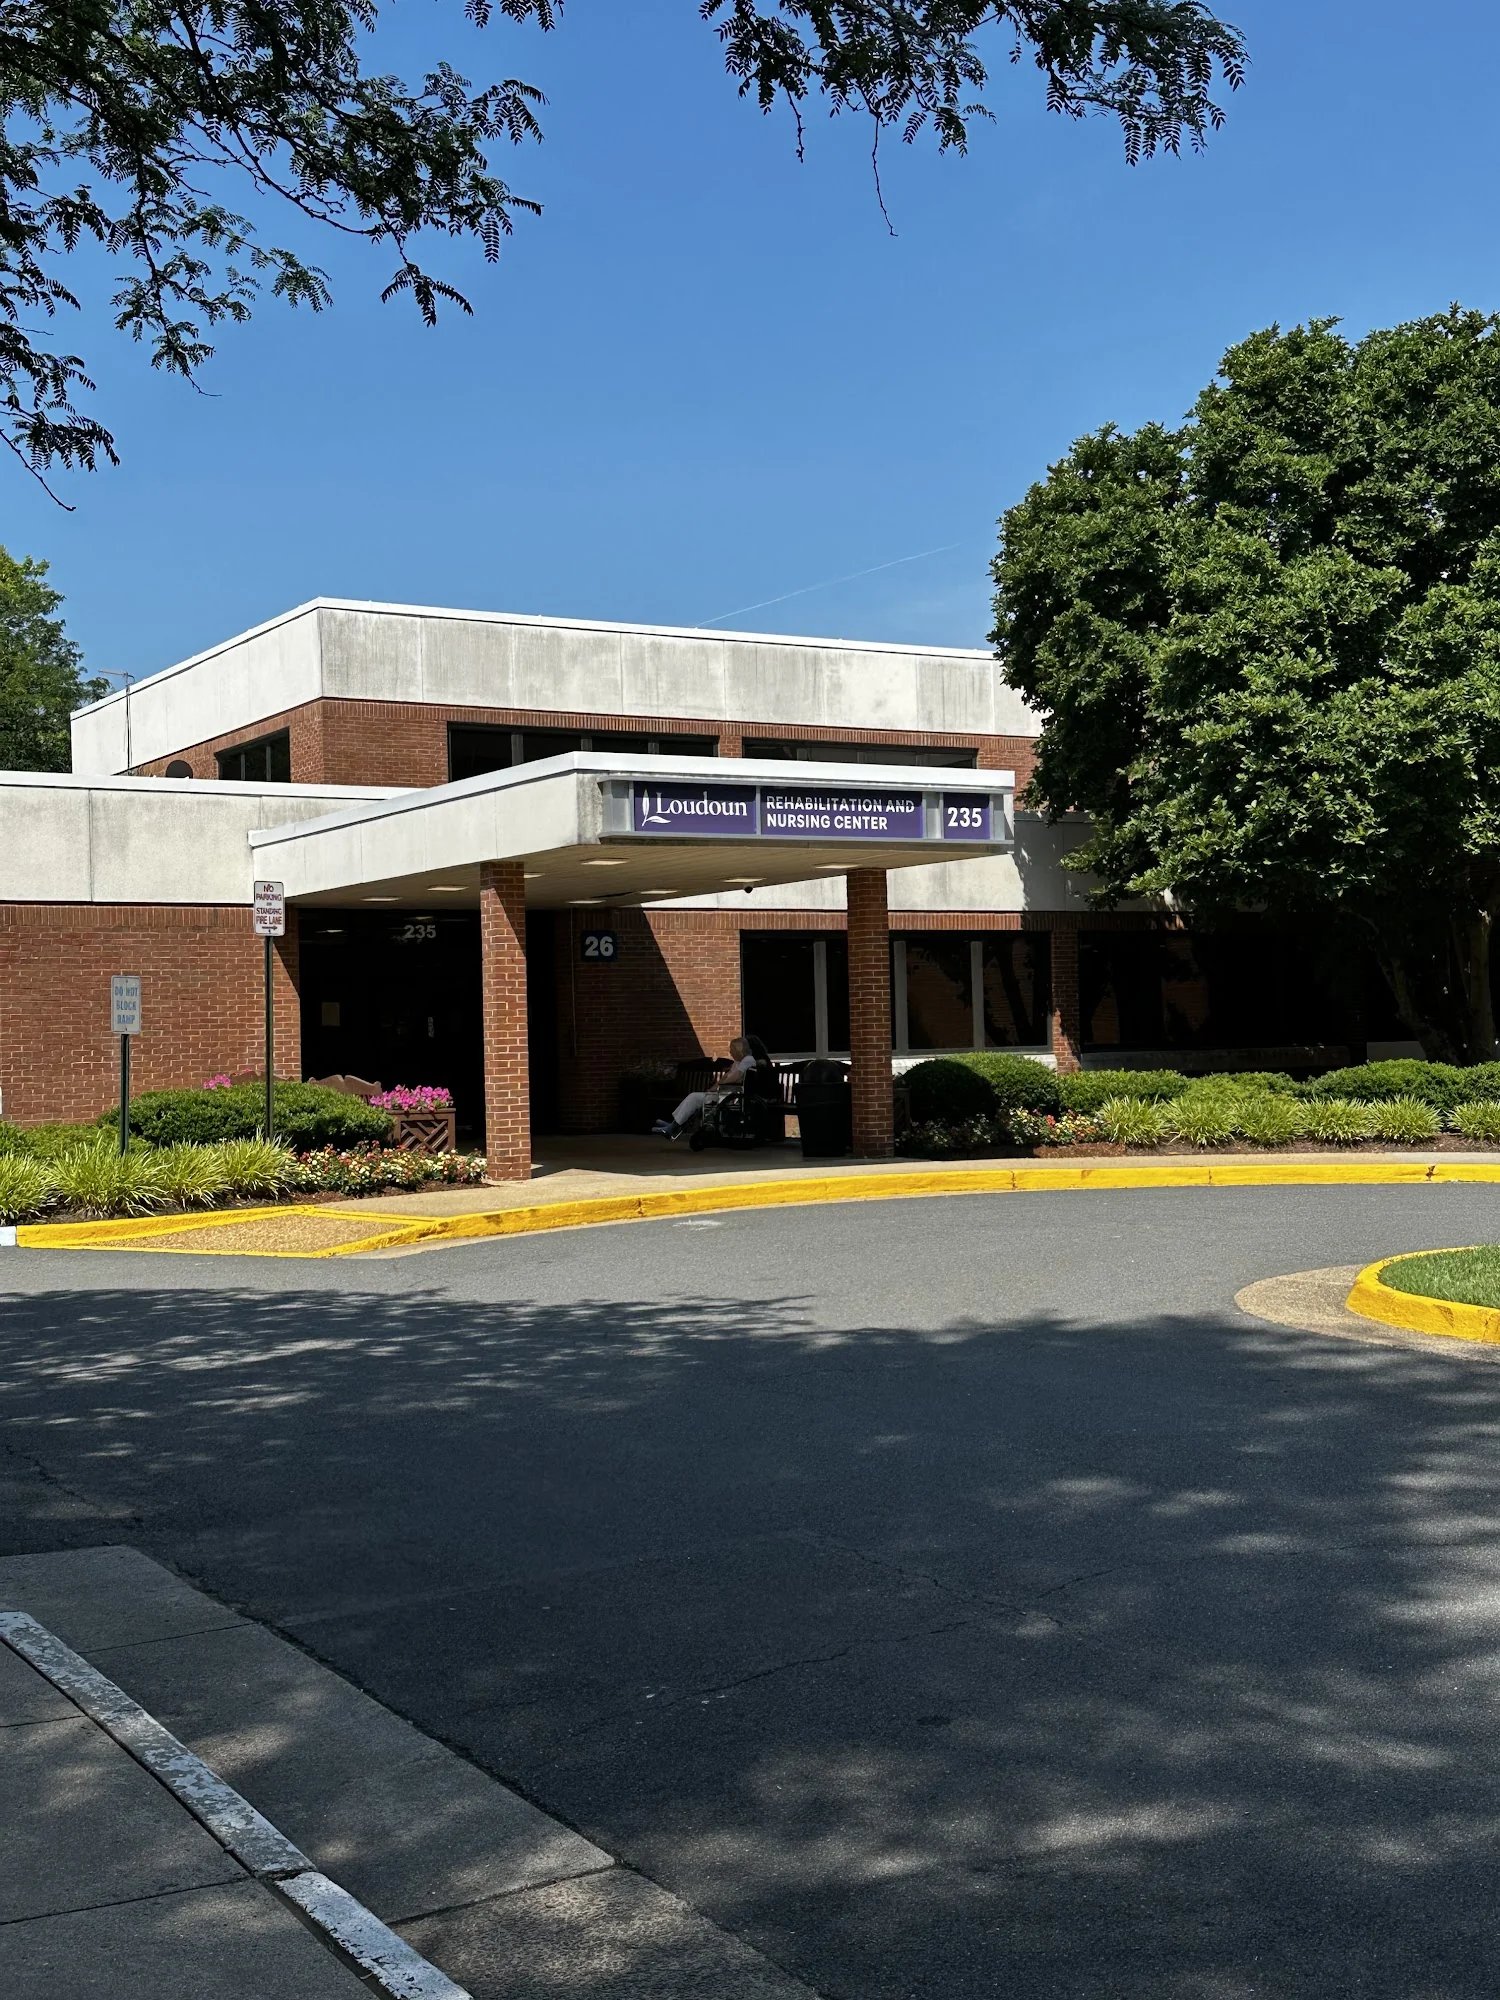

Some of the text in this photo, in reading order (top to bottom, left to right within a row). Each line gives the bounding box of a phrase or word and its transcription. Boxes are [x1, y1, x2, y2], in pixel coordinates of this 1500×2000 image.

[656, 791, 747, 816] Loudoun
[766, 796, 915, 813] REHABILITATION AND
[767, 813, 888, 830] NURSING CENTER
[947, 807, 982, 827] 235
[263, 884, 274, 892] NO
[256, 893, 282, 901] PARKING
[256, 916, 282, 925] FIRE LANE
[402, 925, 436, 938] 235
[585, 936, 613, 956] 26
[115, 986, 138, 996] DO NOT
[116, 1000, 137, 1010] BLOCK
[117, 1014, 135, 1024] RAMP
